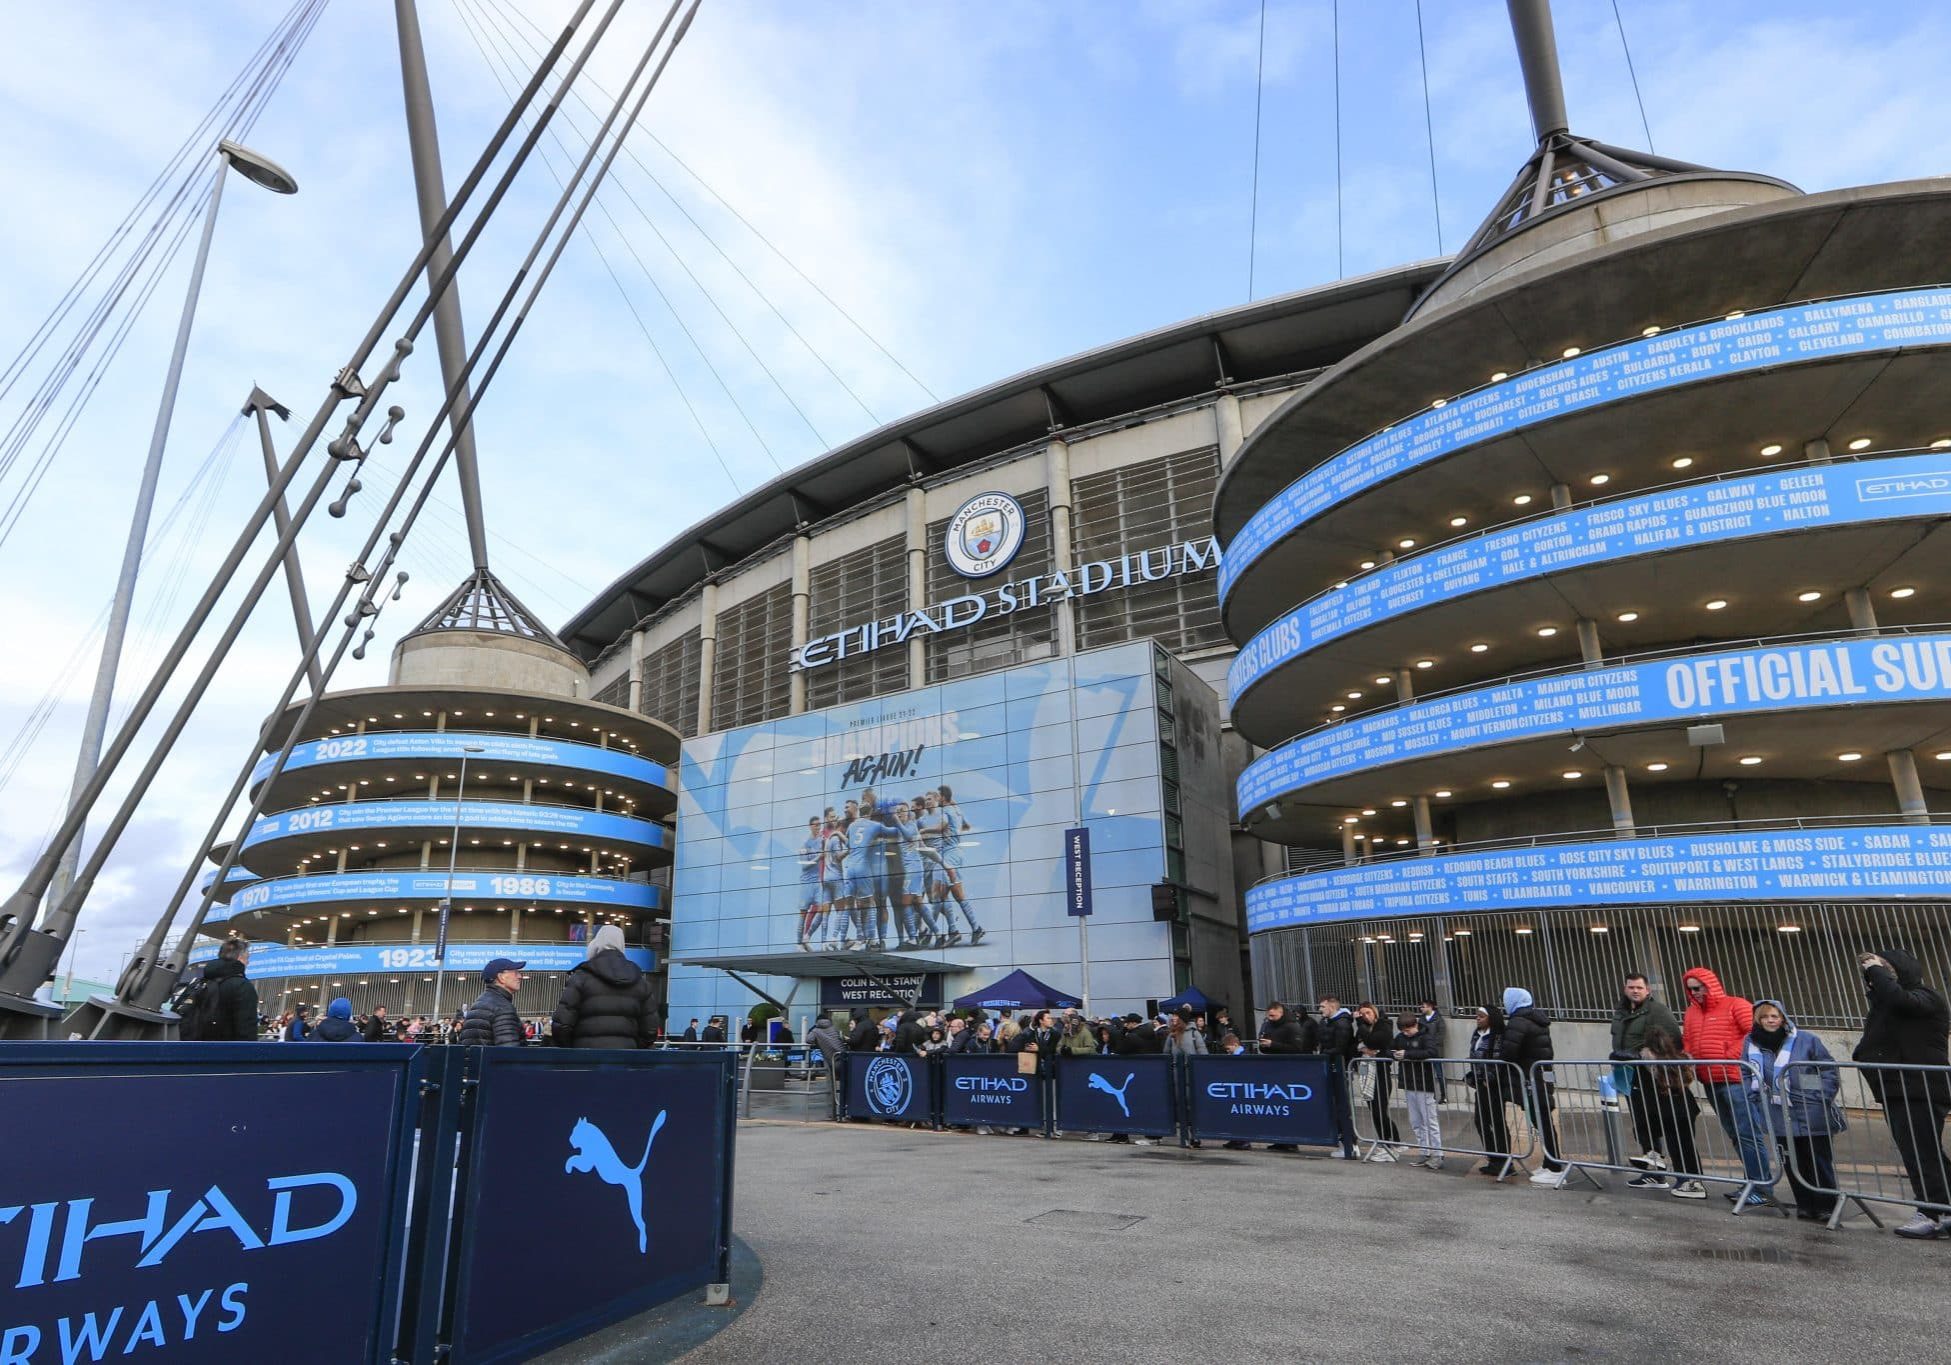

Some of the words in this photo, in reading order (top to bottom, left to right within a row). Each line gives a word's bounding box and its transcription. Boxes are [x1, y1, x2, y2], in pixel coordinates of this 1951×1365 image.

[1370, 442, 1405, 466] BRISBANE
[1414, 426, 1445, 446] BROOKS
[1446, 417, 1463, 432] BAR
[1475, 395, 1526, 422] BUCHAREST
[1539, 379, 1577, 399] BUENOS
[1579, 370, 1609, 388] AIRES
[1624, 352, 1676, 375] BULGARIA
[1692, 342, 1721, 359] BURY
[1737, 332, 1772, 349] CAIRO
[1788, 320, 1840, 340] CALGARY
[1857, 311, 1924, 329] CAMARILLO
[1390, 427, 1412, 444] BLUES
[1424, 411, 1458, 429] ATLANTA
[1460, 392, 1500, 413] CITYZENS
[1515, 366, 1575, 394] AUDENSHAW
[1593, 351, 1629, 370] AUSTIN
[1648, 333, 1695, 355] BAGULEY
[1699, 331, 1707, 343] &
[1710, 315, 1784, 340] BROOKLANDS
[1804, 302, 1874, 322] BALLYMENA
[1376, 459, 1397, 477] BLUES
[1408, 440, 1442, 461] CHORLEY
[1455, 416, 1503, 442] CINCINNATI
[1565, 387, 1600, 406] BRASIL
[1617, 369, 1667, 391] CITYZENS
[1669, 358, 1712, 378] KERALA
[1730, 345, 1780, 365] CLAYTON
[1799, 332, 1864, 352] CLEVELAND
[1865, 478, 1950, 494] ETIHAD
[952, 497, 1015, 532] MANCHESTER
[1354, 578, 1381, 597] FINLAND
[1393, 563, 1422, 582] FLIXTON
[1437, 548, 1468, 566] FRANCE
[1485, 534, 1519, 552] FRESNO
[1522, 521, 1568, 542] CITYZENS
[1587, 507, 1625, 526] FRISCO
[1628, 502, 1649, 518] SKY
[1654, 495, 1688, 513] BLUES
[1707, 483, 1755, 502] GALWAY
[1780, 473, 1824, 491] GELEEN
[1380, 574, 1424, 600] GLOUCESTER
[1425, 573, 1432, 584] &
[1433, 556, 1488, 582] CHELTENHAM
[1501, 548, 1520, 563] GOA
[1534, 534, 1573, 554] GORTON
[1588, 522, 1624, 540] GRAND
[1627, 514, 1667, 533] RAPIDS
[1684, 499, 1754, 522] GUANGZHOU
[1757, 494, 1786, 510] BLUE
[1789, 488, 1827, 506] MOON
[973, 559, 996, 572] CITY
[1387, 588, 1425, 610] GUERNSEY
[1443, 572, 1480, 592] GUIYANG
[1503, 559, 1524, 576] HALE
[1529, 556, 1537, 569] &
[1541, 541, 1607, 566] ALTRINCHAM
[1634, 526, 1680, 546] HALIFAX
[1686, 523, 1694, 537] &
[1700, 514, 1752, 535] DISTRICT
[1783, 503, 1830, 522] HALTON
[799, 593, 987, 671] ETIHAD
[998, 535, 1225, 616] STADIUM
[1258, 616, 1300, 670] CLUBS
[1410, 703, 1451, 722] MALLORCA
[1453, 696, 1479, 712] BLUES
[1492, 687, 1524, 704] MALTA
[1537, 677, 1585, 696] MANIPUR
[1588, 669, 1638, 688] CITYZENS
[1666, 647, 1867, 709] OFFICIAL
[850, 716, 875, 728] PREMIER
[1382, 730, 1396, 743] MID
[1397, 723, 1426, 739] SUSSEX
[1427, 716, 1452, 732] BLUES
[1467, 703, 1518, 723] MIDDLETON
[1534, 693, 1574, 711] MILANO
[1576, 689, 1603, 705] BLUE
[1606, 685, 1640, 701] MOON
[1404, 733, 1439, 751] MOSSLEY
[1451, 725, 1480, 740] MOUNT
[1483, 718, 1518, 735] VERNON
[1519, 710, 1564, 729] CITYZENS
[1579, 700, 1642, 720] MULLINGAR
[315, 739, 367, 760] 2022
[841, 744, 925, 790] AGAIN!
[288, 809, 334, 831] 2012
[854, 830, 865, 845] 5
[1073, 835, 1081, 859] WEST
[1402, 864, 1434, 877] REDDISH
[1444, 859, 1483, 875] REDONDO
[1484, 857, 1514, 872] BEACH
[1515, 854, 1546, 869] BLUES
[1559, 850, 1586, 865] ROSE
[1588, 848, 1610, 864] CITY
[1614, 847, 1636, 862] SKY
[1639, 845, 1674, 860] BLUES
[1690, 840, 1759, 857] RUSHOLME
[1762, 839, 1771, 854] &
[1773, 838, 1813, 853] MOSS
[1815, 836, 1845, 852] SIDE
[1864, 834, 1911, 849] SABAH
[490, 877, 551, 896] 1986
[1074, 861, 1084, 909] RECEPTION
[1384, 895, 1413, 908] TRIPURA
[1414, 891, 1450, 906] CITYZENS
[1463, 889, 1488, 903] TUNIS
[1502, 884, 1573, 901] ULAANBAATAR
[1588, 880, 1656, 896] VANCOUVER
[1674, 875, 1758, 892] WARRINGTON
[1778, 872, 1849, 888] WARWICK
[1852, 871, 1862, 886] &
[1411, 876, 1447, 893] CITYZENS
[1457, 874, 1485, 888] SOUTH
[1486, 871, 1519, 887] STAFFS
[1531, 868, 1564, 884] SOUTH
[1565, 864, 1626, 881] YORKSHIRE
[1641, 859, 1710, 876] SOUTHPORT
[1713, 858, 1722, 873] &
[1724, 856, 1760, 873] WEST
[1762, 855, 1804, 872] LANCS
[1822, 852, 1914, 868] STALYBRIDGE
[1915, 851, 1951, 866] BLUE
[242, 885, 270, 908] 1970
[378, 949, 441, 968] 1923
[840, 978, 867, 988] COLIN
[869, 976, 891, 987] BLL
[842, 990, 867, 1000] WEST
[869, 1057, 904, 1082] MANCHESTER
[955, 1076, 1028, 1092] ETIHAD
[970, 1094, 1013, 1105] AIRWAYS
[1207, 1082, 1313, 1100] ETIHAD
[886, 1105, 899, 1114] CITY
[1230, 1103, 1290, 1116] AIRWAYS
[0, 1282, 248, 1365] RWAYS
